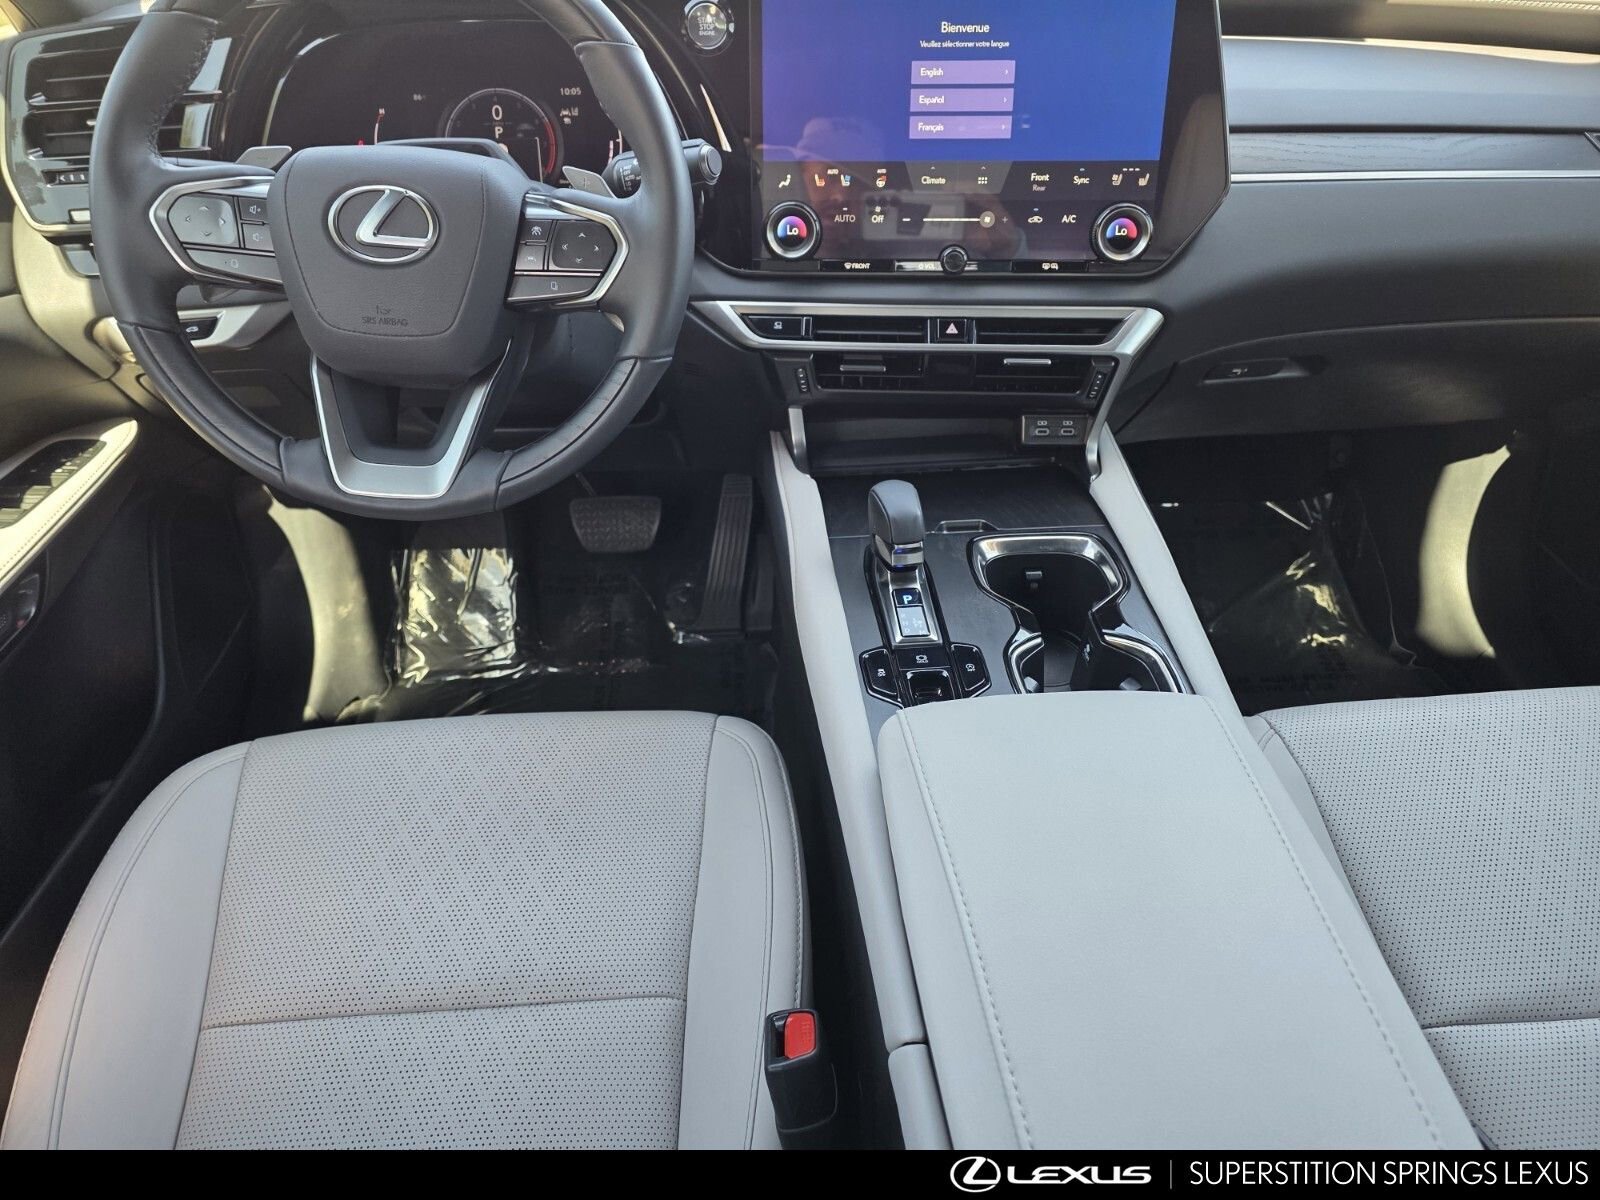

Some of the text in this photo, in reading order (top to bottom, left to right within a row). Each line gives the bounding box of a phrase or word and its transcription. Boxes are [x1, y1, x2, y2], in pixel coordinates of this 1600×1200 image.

[941, 21, 990, 33] Bienvenue
[920, 40, 1010, 49] Veuillez sélectionner votre langue
[920, 67, 944, 78] English
[560, 87, 582, 96] 10:05
[918, 95, 944, 105] Español
[494, 126, 504, 139] P
[917, 123, 944, 133] Français
[921, 175, 946, 185] Climate
[1030, 173, 1050, 182] Front
[1073, 176, 1090, 186] Sync
[1032, 184, 1047, 192] Rear
[834, 214, 856, 223] AUTO
[871, 215, 885, 223] Off
[1061, 215, 1077, 223] A/C
[786, 225, 799, 236] Lo
[1115, 225, 1128, 236] Lo
[902, 595, 912, 604] P
